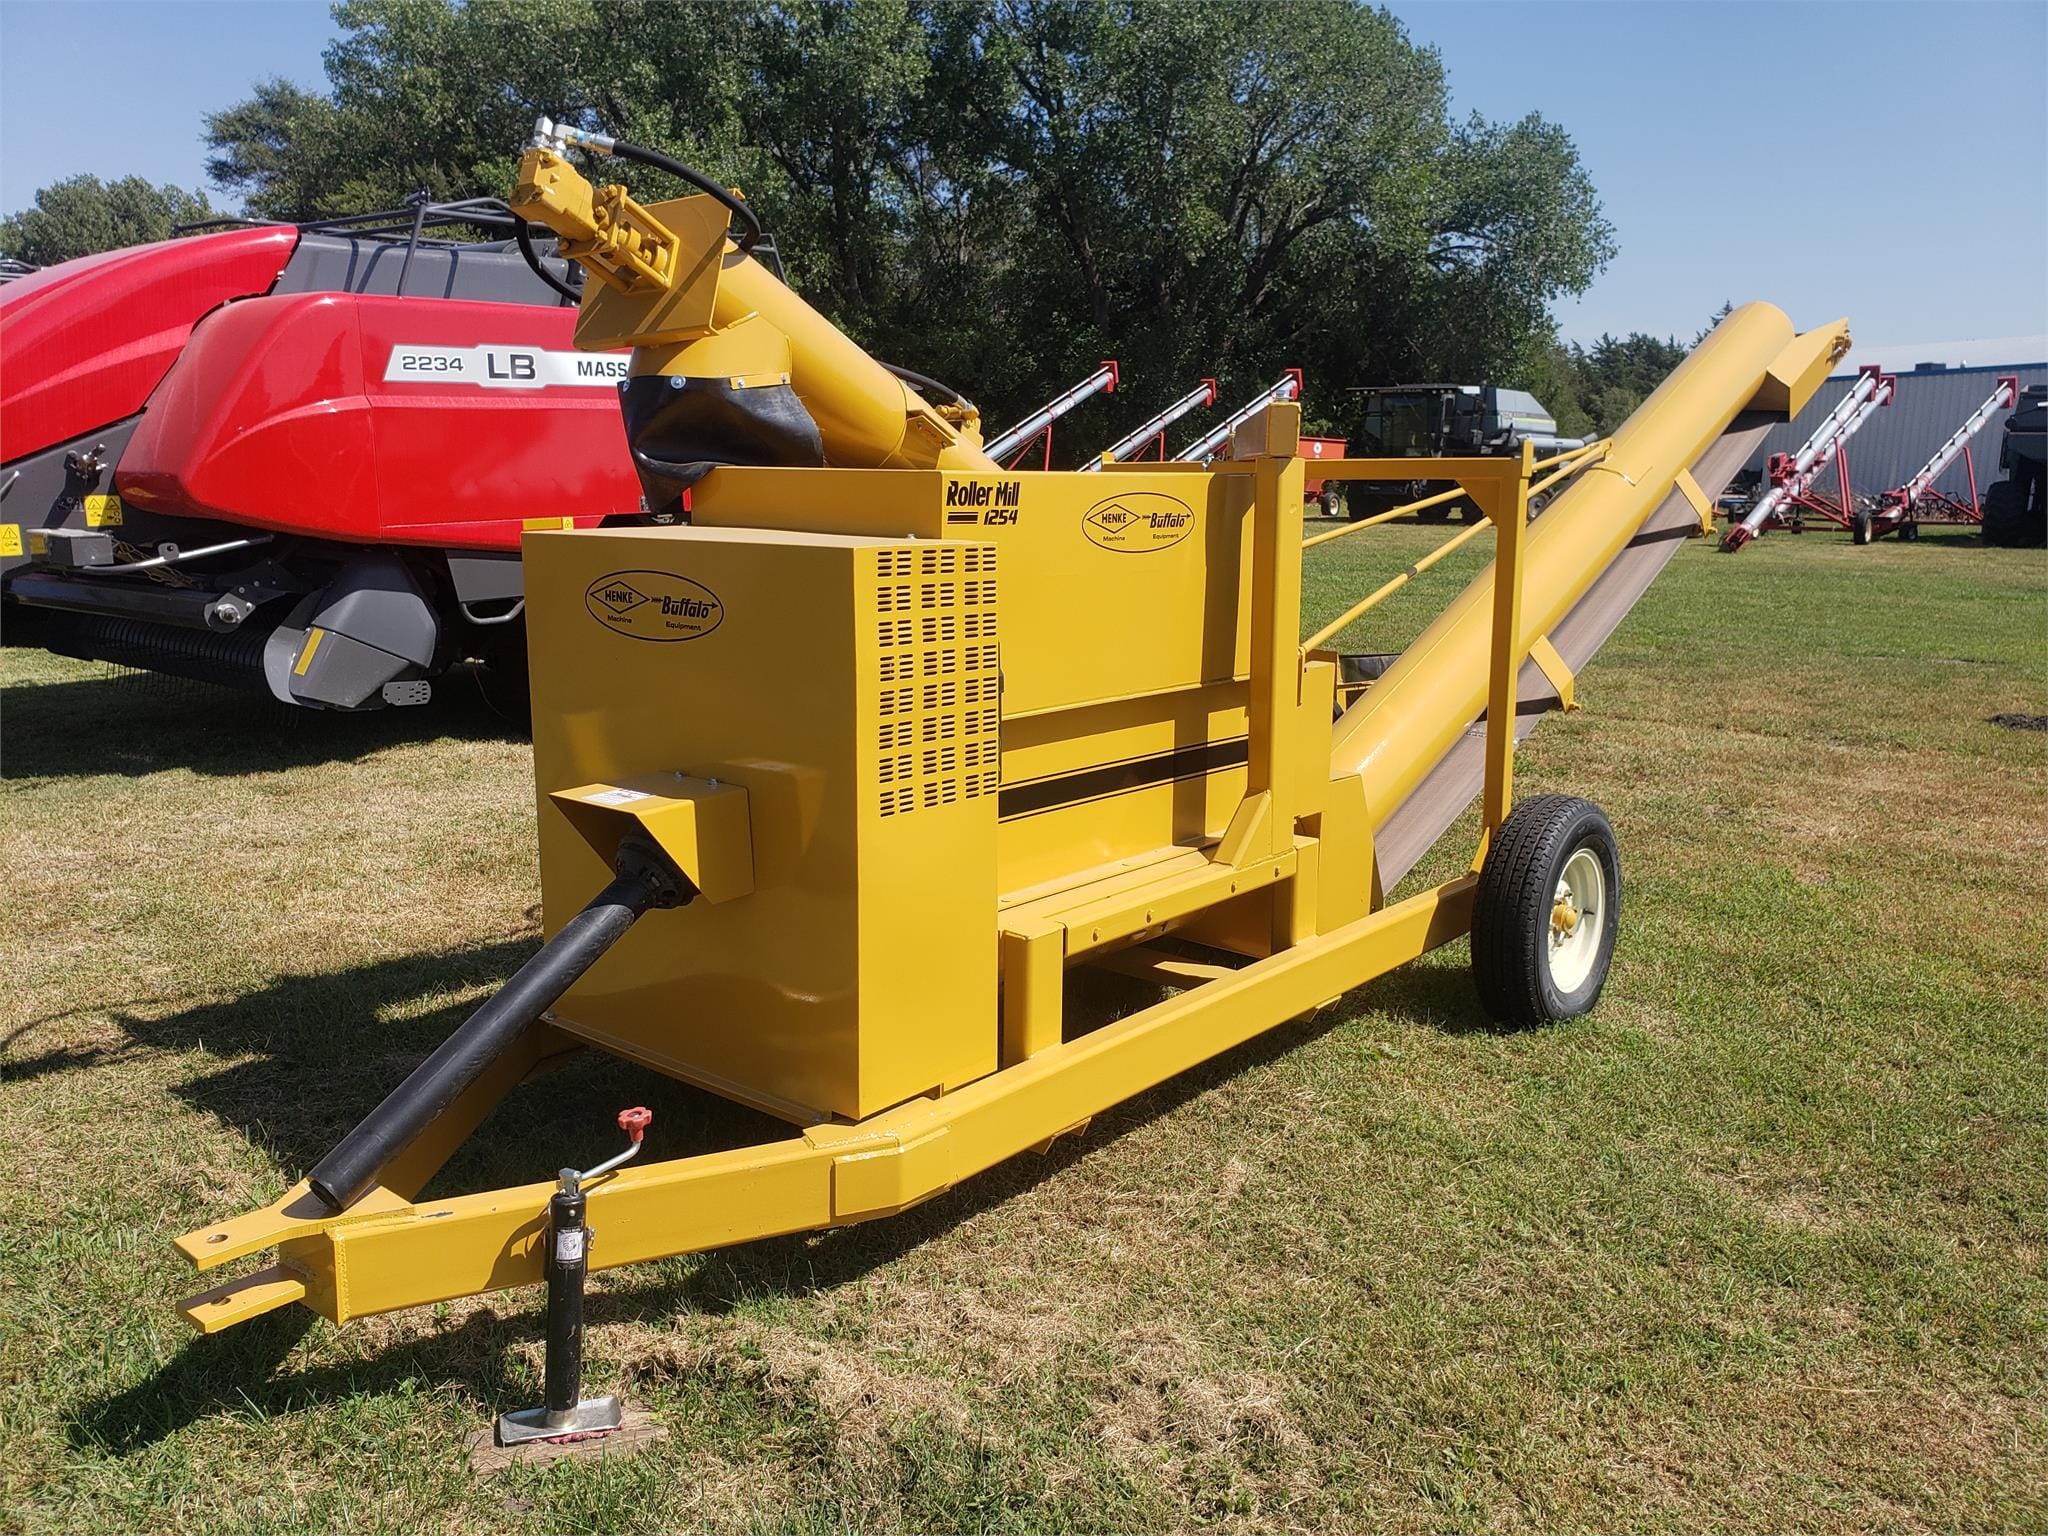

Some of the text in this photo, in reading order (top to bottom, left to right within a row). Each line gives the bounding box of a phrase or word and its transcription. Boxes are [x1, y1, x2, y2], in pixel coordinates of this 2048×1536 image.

[402, 353, 628, 380] 2234 LB MASS
[946, 480, 1020, 507] Roller Mill
[983, 510, 1018, 525] 1254
[1101, 512, 1186, 529] HENKE Buffalo
[1102, 533, 1180, 543] Machine Equipment
[604, 590, 710, 619] HENKE Buffalo
[607, 615, 702, 632] Machine Equipment
